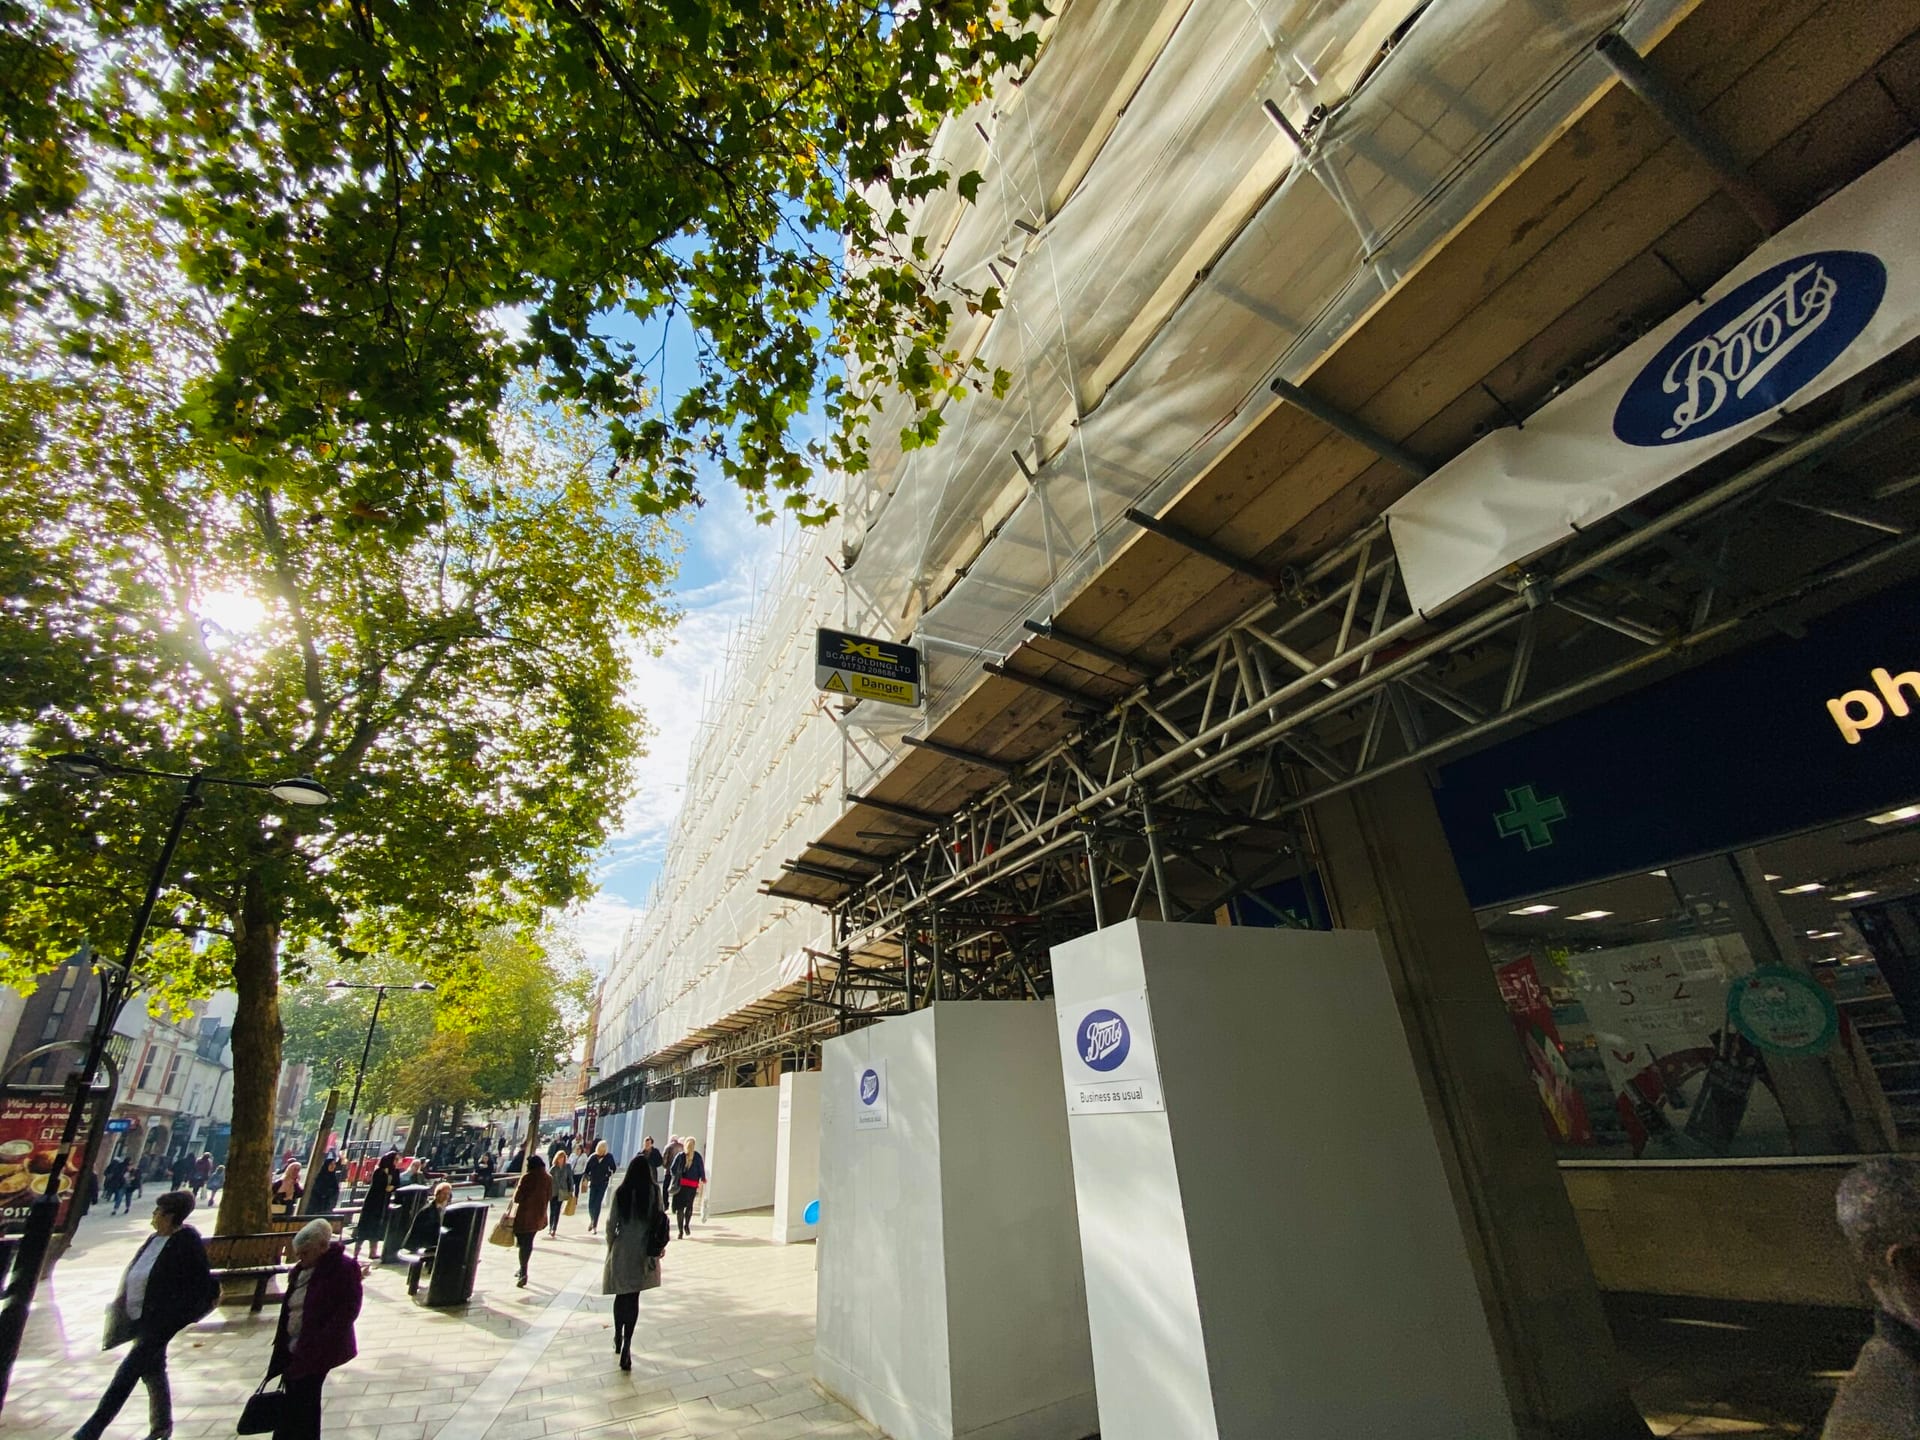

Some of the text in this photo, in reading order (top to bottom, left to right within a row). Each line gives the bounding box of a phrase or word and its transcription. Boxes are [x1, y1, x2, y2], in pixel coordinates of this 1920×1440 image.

[1661, 260, 1837, 440] Boots
[826, 650, 911, 674] SCAFFOLDING LTD
[861, 677, 905, 693] Danger
[1085, 1018, 1122, 1062] Boots
[1080, 1087, 1143, 1103] Business as usual
[7, 1098, 32, 1109] Wake
[35, 1102, 48, 1111] up
[49, 1101, 60, 1109] to
[1, 1110, 23, 1119] deal
[23, 1113, 50, 1122] every
